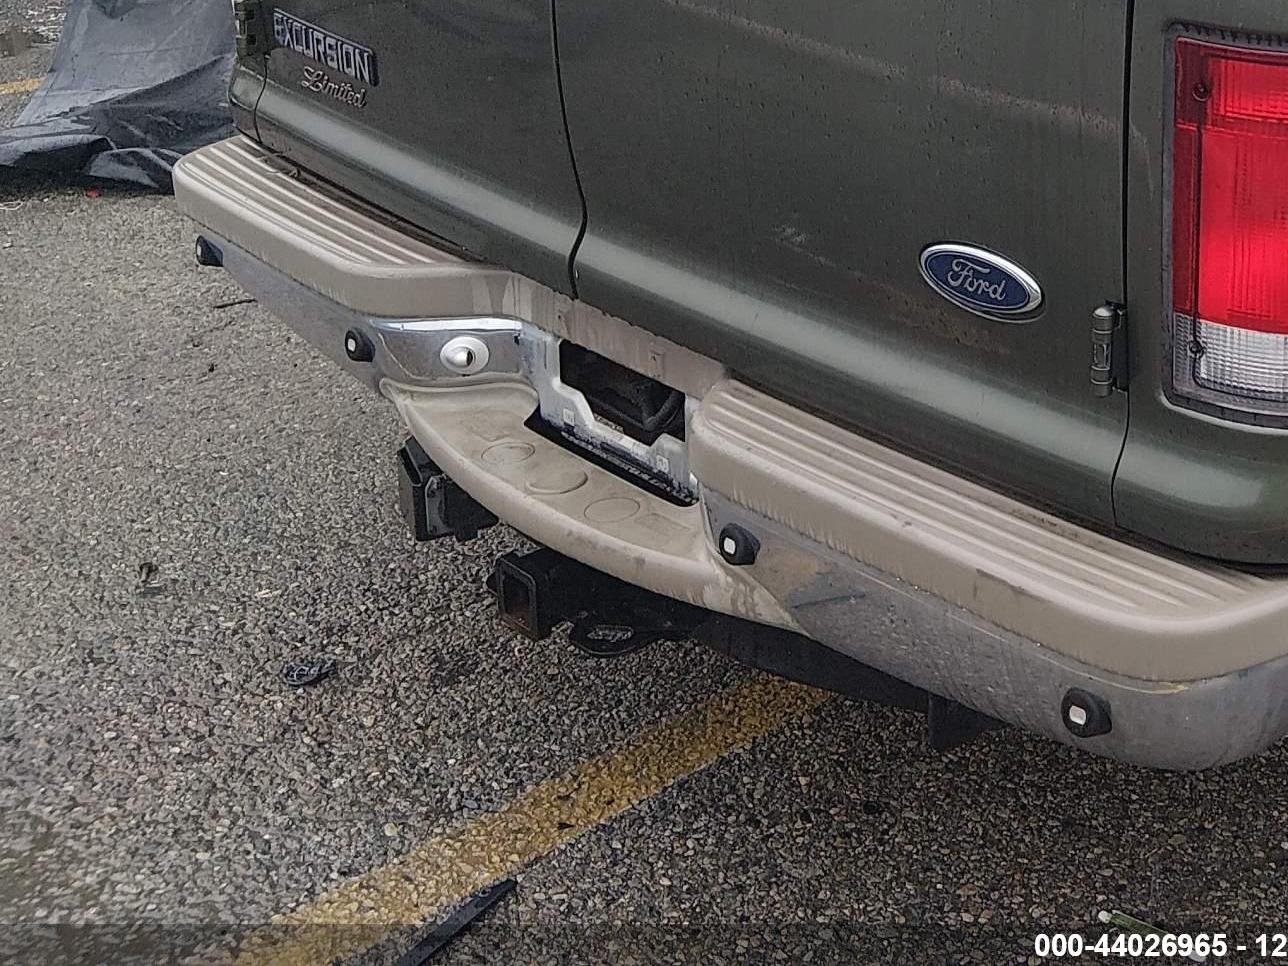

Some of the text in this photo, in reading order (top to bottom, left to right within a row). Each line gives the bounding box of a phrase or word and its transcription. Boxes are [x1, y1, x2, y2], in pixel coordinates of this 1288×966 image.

[273, 12, 370, 84] EXCURSION
[301, 66, 366, 108] Limited
[947, 258, 1006, 301] Ford
